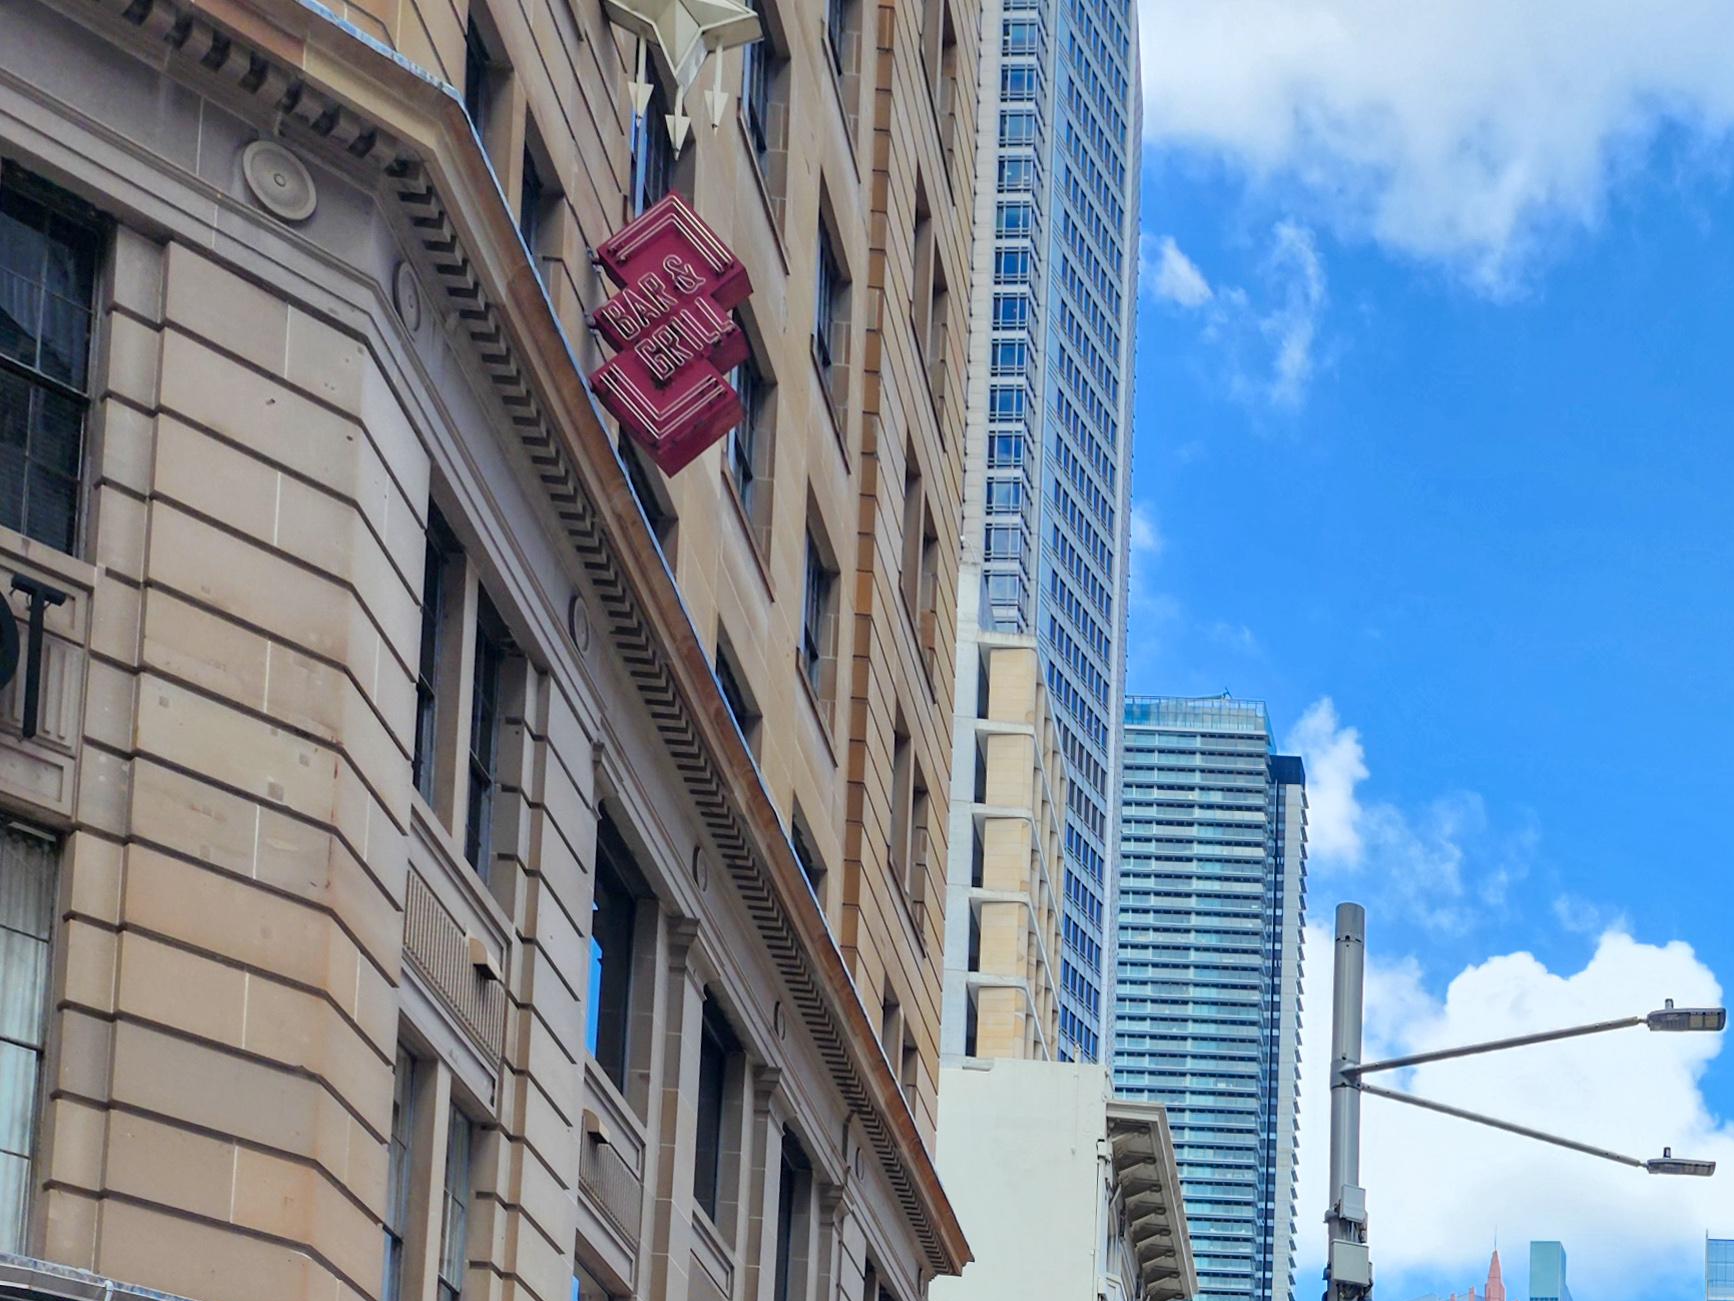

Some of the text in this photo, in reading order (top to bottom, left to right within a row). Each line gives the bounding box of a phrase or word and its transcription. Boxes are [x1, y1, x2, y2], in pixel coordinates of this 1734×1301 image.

[602, 254, 706, 341] BAR &
[634, 297, 737, 381] GRILL
